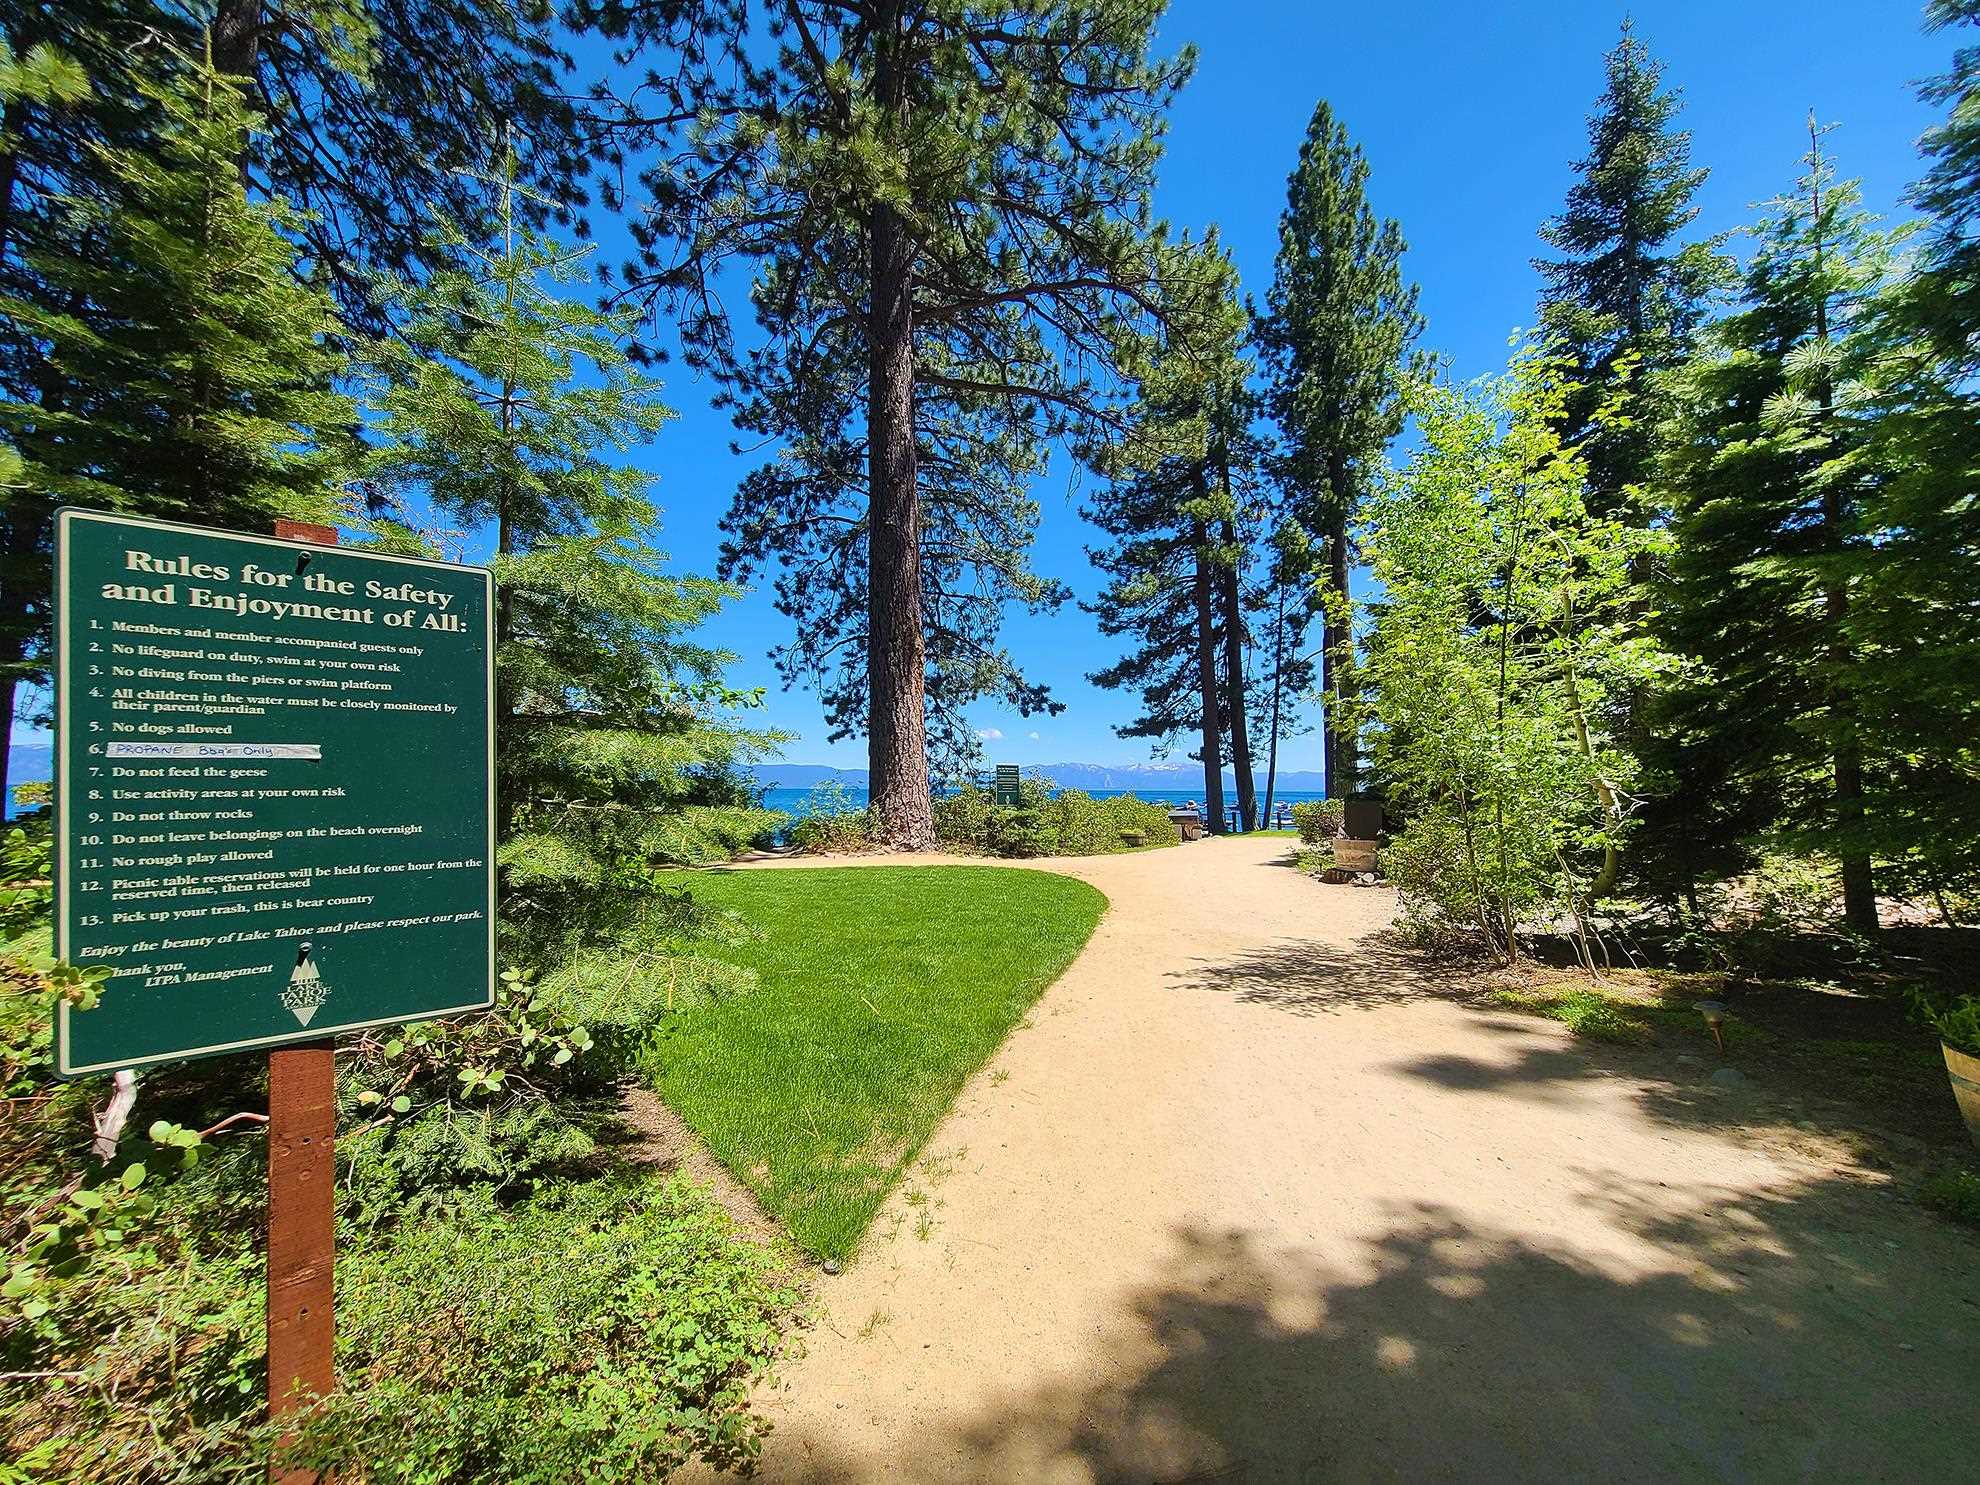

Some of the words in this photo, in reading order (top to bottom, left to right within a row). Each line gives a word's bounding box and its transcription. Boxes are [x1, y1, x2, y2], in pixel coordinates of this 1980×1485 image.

[125, 551, 230, 580] Rules
[241, 565, 293, 587] for
[303, 573, 354, 595] the
[366, 581, 454, 610] Safety
[102, 583, 177, 605] and
[189, 588, 374, 624] Enjoyment
[383, 610, 416, 627] of
[91, 620, 103, 629] 1.
[112, 622, 181, 635] Members
[184, 627, 211, 638] and
[215, 632, 272, 642] member
[275, 637, 357, 649] accompanied
[360, 644, 396, 652] guests
[399, 646, 423, 656] only
[89, 642, 103, 651] 2.
[112, 644, 134, 655] No
[138, 645, 204, 660] lifeguard
[207, 653, 226, 662] on
[265, 656, 300, 665] swim
[378, 663, 400, 672] risk
[89, 665, 103, 675] 3.
[112, 666, 134, 676] No
[138, 668, 185, 681] diving
[188, 671, 222, 680] from
[226, 673, 248, 682] the
[252, 675, 285, 685] piers
[305, 679, 338, 687] swim
[341, 680, 392, 690] platform
[89, 687, 104, 697] 4.
[112, 689, 133, 698] All
[137, 690, 199, 701] children
[203, 693, 217, 702] in
[221, 694, 243, 704] the
[247, 697, 284, 705] water
[322, 698, 337, 707] be
[340, 699, 381, 711] closely
[384, 703, 441, 711] monitored
[445, 703, 458, 714] by
[112, 701, 150, 710] their
[153, 704, 265, 715] parent/guardian
[90, 722, 104, 731] 5.
[112, 723, 134, 732] No
[138, 723, 173, 735] dogs
[177, 724, 232, 734] allowed
[88, 743, 104, 754] 6.
[116, 743, 183, 755] PROPANE
[243, 745, 273, 758] Only
[89, 768, 104, 776] 7.
[112, 767, 135, 776] Do
[168, 767, 200, 776] feed
[204, 767, 227, 776] the
[230, 770, 267, 778] geese
[89, 790, 103, 799] 8.
[113, 790, 141, 799] Use
[144, 789, 198, 800] activity
[258, 790, 289, 799] your
[322, 787, 345, 796] risk
[89, 813, 103, 823] 9.
[112, 812, 135, 821] Do
[139, 813, 165, 821] not
[169, 811, 211, 821] throw
[215, 809, 253, 818] rocks
[81, 836, 103, 845] 10.
[112, 835, 135, 844] Do
[139, 835, 164, 843] not
[169, 833, 205, 841] leave
[209, 830, 283, 841] belongings
[307, 828, 327, 836] the
[330, 826, 365, 835] beach
[368, 825, 422, 835] overnight
[81, 859, 103, 868] 11.
[112, 857, 135, 866] No
[138, 854, 182, 866] rough
[187, 853, 217, 865] play
[220, 850, 273, 861] allowed
[81, 881, 103, 891] 12.
[113, 878, 159, 889] Picnic
[163, 875, 200, 887] table
[203, 871, 286, 884] reservations
[288, 868, 312, 878] will
[316, 868, 331, 876] be
[334, 865, 360, 875] held
[364, 865, 381, 873] for
[437, 861, 463, 869] from
[465, 858, 482, 867] the
[112, 887, 177, 900] reserved
[222, 884, 253, 892] then
[257, 879, 310, 890] released
[80, 916, 103, 926] 13.
[113, 912, 146, 923] Pick
[150, 912, 169, 921] up
[173, 909, 207, 920] your
[254, 902, 279, 911] this
[296, 899, 324, 908] bear
[327, 896, 374, 905] country
[79, 945, 129, 958] Enjoy
[132, 941, 159, 952] the
[162, 937, 215, 949] beauty
[217, 933, 236, 943] of
[236, 930, 270, 941] Lake
[275, 927, 314, 937] Tahoe
[316, 923, 342, 933] and
[344, 921, 384, 933] please
[387, 916, 430, 927] respect
[112, 964, 151, 978] hank
[144, 975, 181, 988] LTPA
[184, 964, 274, 983] Management
